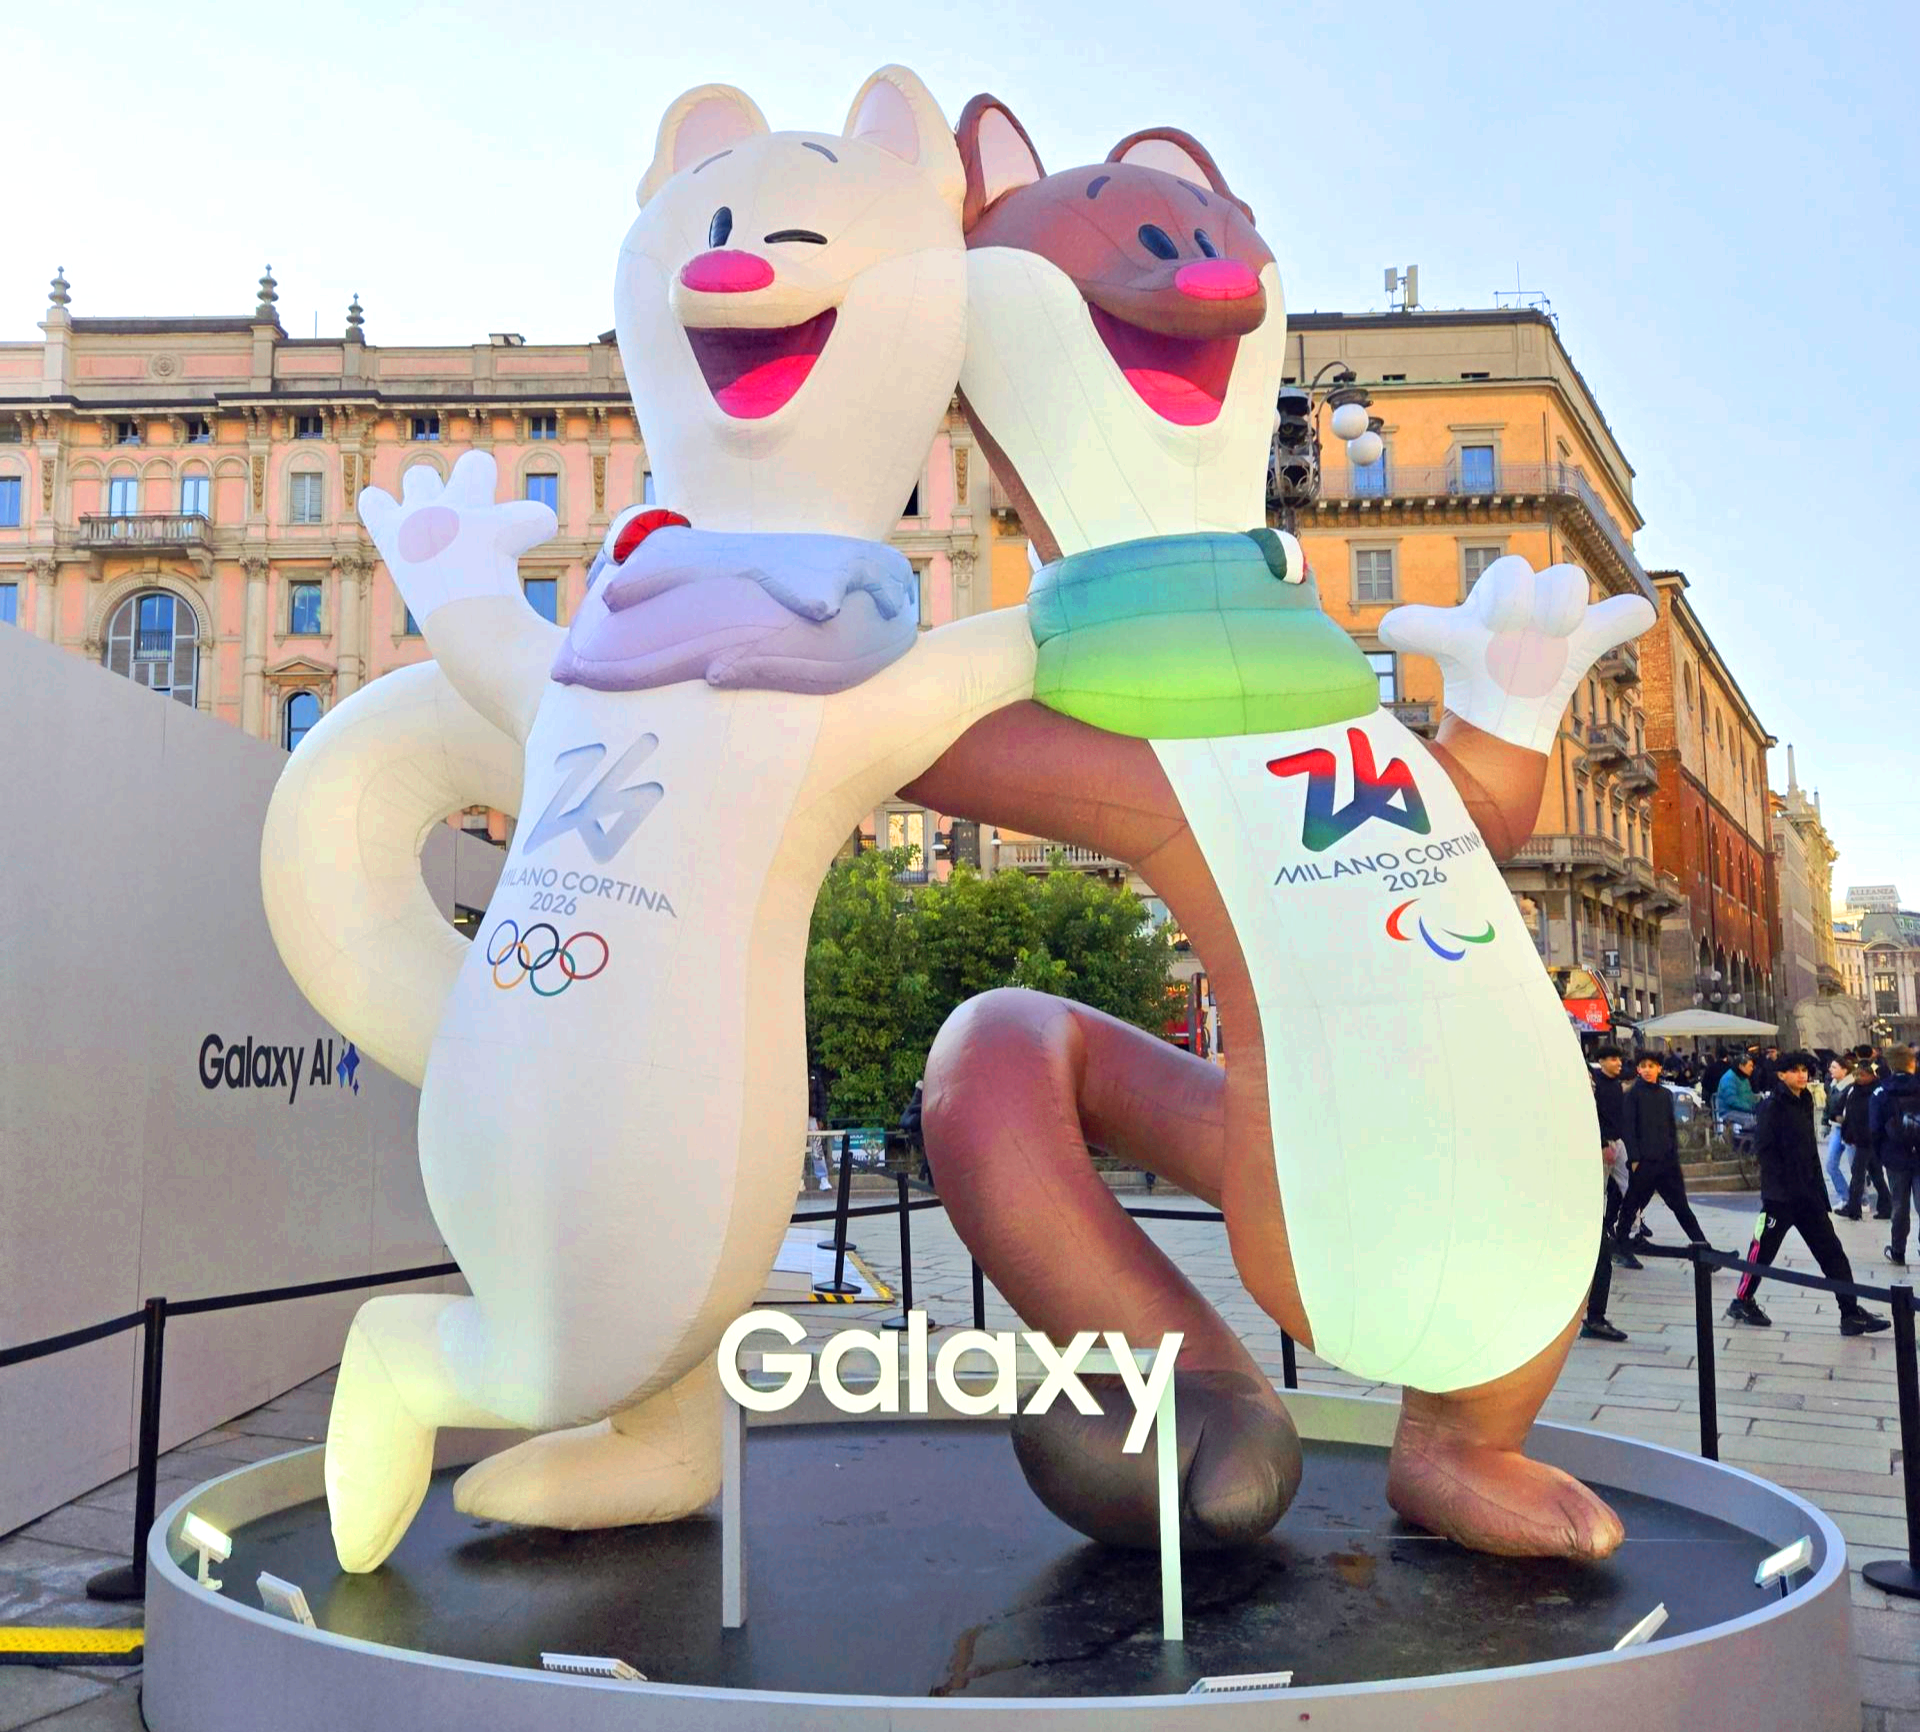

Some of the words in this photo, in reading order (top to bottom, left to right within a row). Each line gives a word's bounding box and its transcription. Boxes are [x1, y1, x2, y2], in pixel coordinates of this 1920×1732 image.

[1273, 852, 1400, 886] MILANO
[1382, 866, 1448, 893] 2026
[529, 890, 578, 917] 2026
[562, 871, 678, 919] CORTINA
[198, 1033, 306, 1105] Galaxy
[309, 1038, 333, 1086] AI
[717, 1309, 1185, 1454] Galaxy
